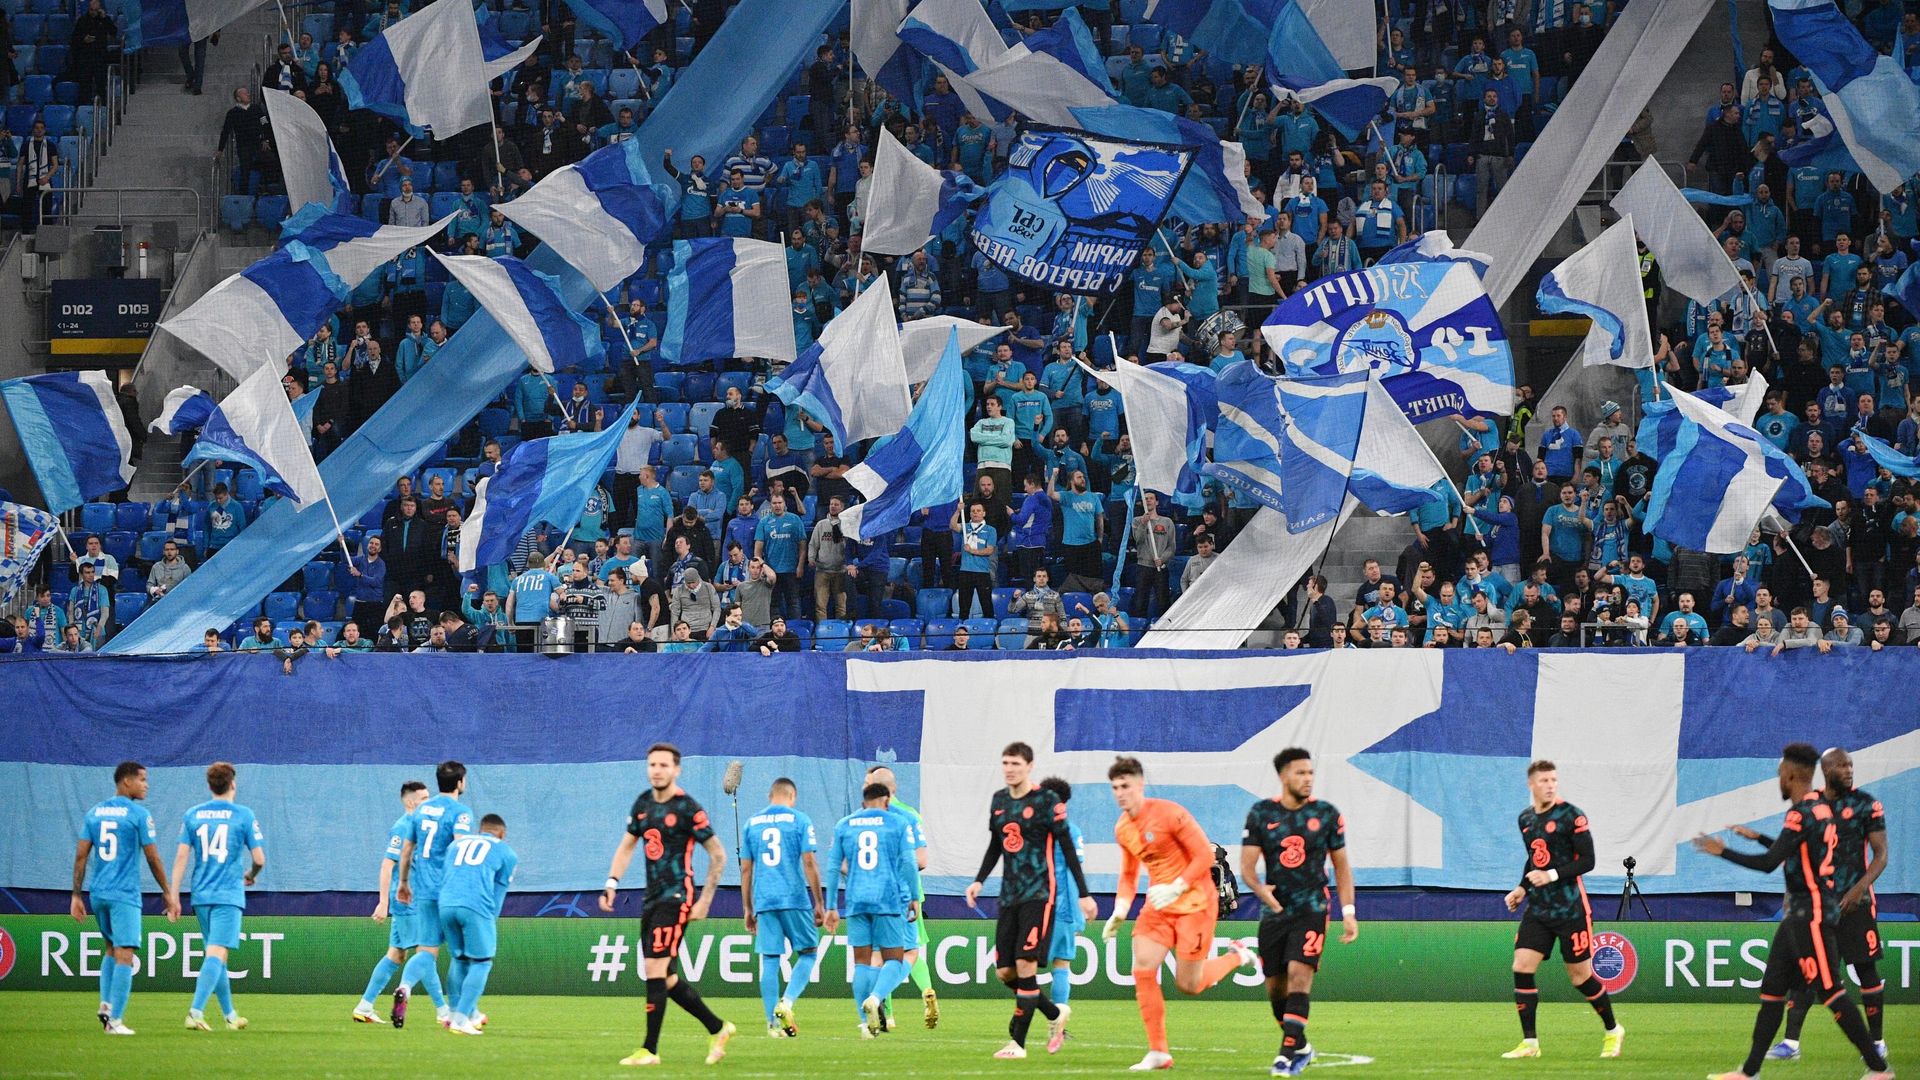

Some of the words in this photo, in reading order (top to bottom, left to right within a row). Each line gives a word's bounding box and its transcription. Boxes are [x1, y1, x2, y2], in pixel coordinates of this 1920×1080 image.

[62, 304, 93, 315] D102
[118, 304, 149, 315] D103
[849, 816, 884, 826] WENDEL
[98, 821, 118, 862] 5
[196, 823, 229, 864] 14
[421, 819, 438, 858] 7
[761, 827, 781, 867] 3
[857, 830, 878, 871] 8
[454, 839, 492, 866] 10
[652, 927, 673, 947] 17
[1026, 926, 1039, 947] 4
[1571, 930, 1589, 952] 18
[1866, 930, 1877, 949] 9
[1665, 937, 1920, 989] REST
